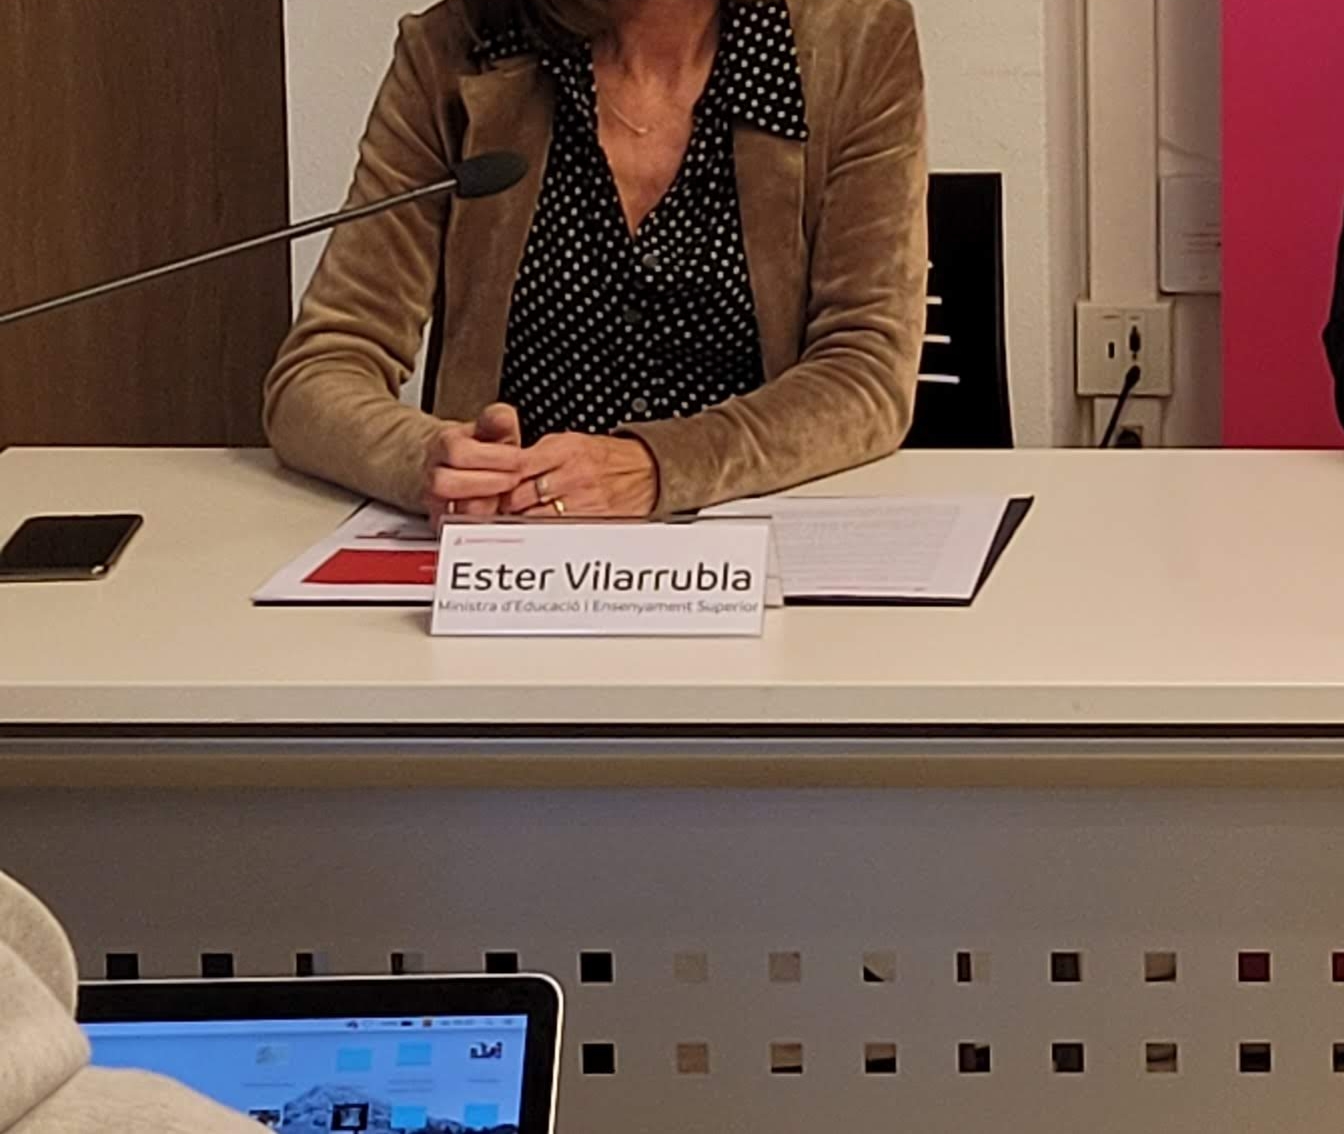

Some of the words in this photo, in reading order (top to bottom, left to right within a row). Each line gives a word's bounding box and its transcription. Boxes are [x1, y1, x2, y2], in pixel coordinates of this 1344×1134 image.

[450, 561, 554, 591] Ester
[565, 560, 752, 592] Vilarrubla
[438, 600, 497, 613] Ministra
[697, 600, 758, 616] Superior
